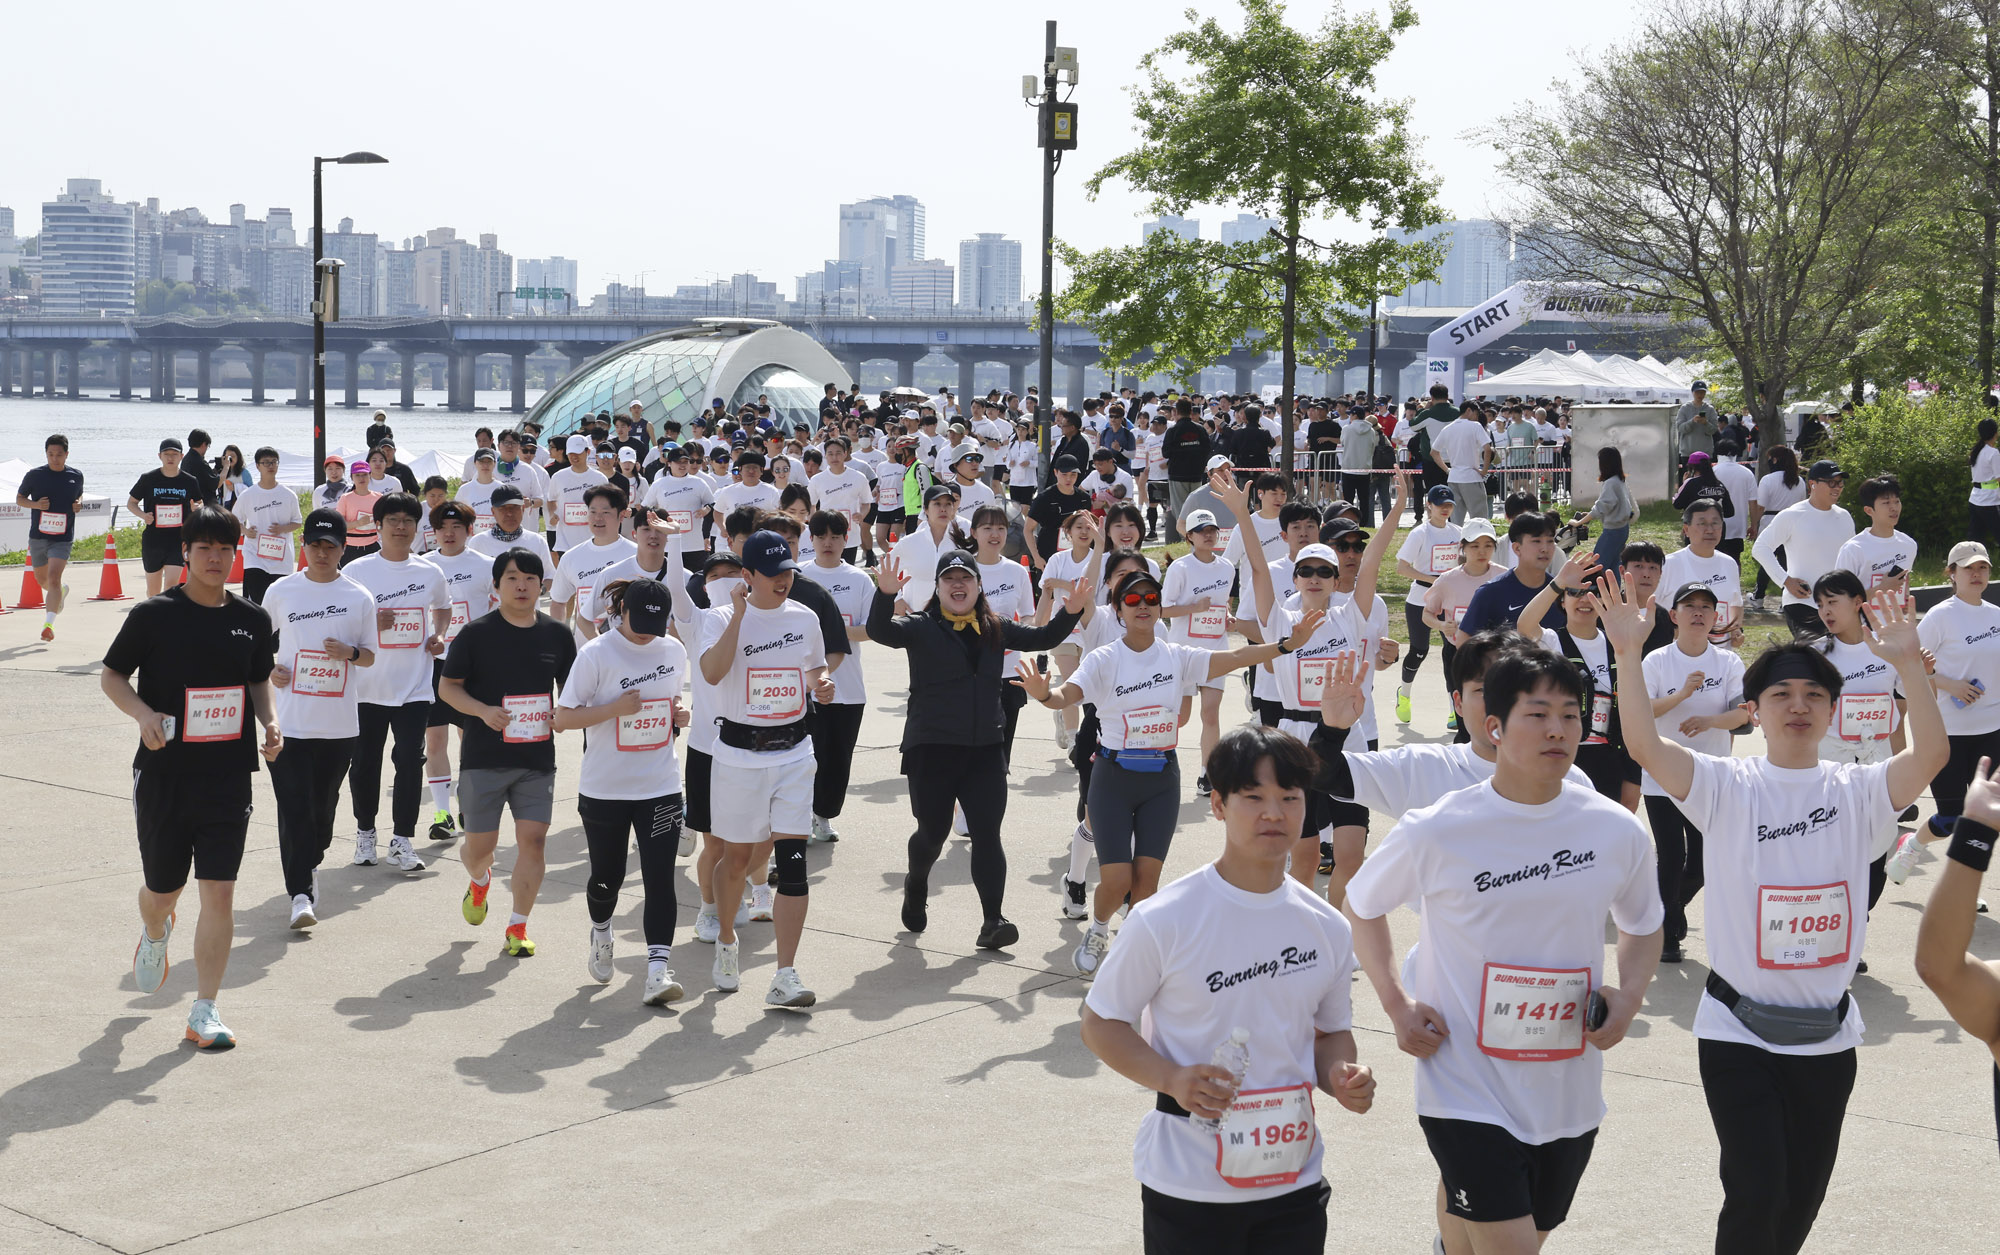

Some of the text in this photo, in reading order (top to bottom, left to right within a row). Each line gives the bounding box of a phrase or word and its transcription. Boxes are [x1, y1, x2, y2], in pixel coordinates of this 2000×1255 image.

[1450, 300, 1511, 345] START
[316, 520, 332, 528] Jeep
[1872, 559, 1895, 572] Burning
[454, 574, 472, 582] Run
[1713, 574, 1726, 582] Run
[376, 584, 425, 603] Burning Run
[833, 584, 850, 592] Run
[1000, 584, 1014, 592] Run
[1192, 580, 1228, 596] Burning Run
[288, 606, 348, 622] Burning Run
[1201, 616, 1222, 625] 3534
[393, 622, 420, 632] 1706
[1965, 630, 1992, 644] Burning
[744, 632, 804, 656] Burning Run
[1296, 638, 1348, 658] Burning Run
[310, 667, 340, 678] 2244
[1865, 664, 1887, 674] Run
[620, 664, 674, 690] Burning Run
[1705, 678, 1722, 688] Run
[1116, 673, 1174, 696] Burning Run
[763, 686, 796, 698] 2030
[204, 706, 236, 719] 1810
[520, 712, 548, 722] 2406
[1856, 710, 1887, 720] 3452
[624, 717, 666, 730] W 3574
[1142, 722, 1174, 734] 3566
[1758, 820, 1809, 842] Burning
[1808, 806, 1838, 828] Run
[1474, 850, 1596, 892] Burning Run
[1768, 894, 1804, 902] BURNING
[1769, 914, 1842, 934] M 1088
[1206, 946, 1318, 992] Burning Run
[1494, 974, 1536, 986] BURNING
[1537, 978, 1558, 986] RUN
[1494, 1002, 1576, 1020] M 1412
[1233, 1100, 1262, 1112] RNING
[1264, 1098, 1284, 1108] RUN
[1230, 1120, 1308, 1146] M 1962
